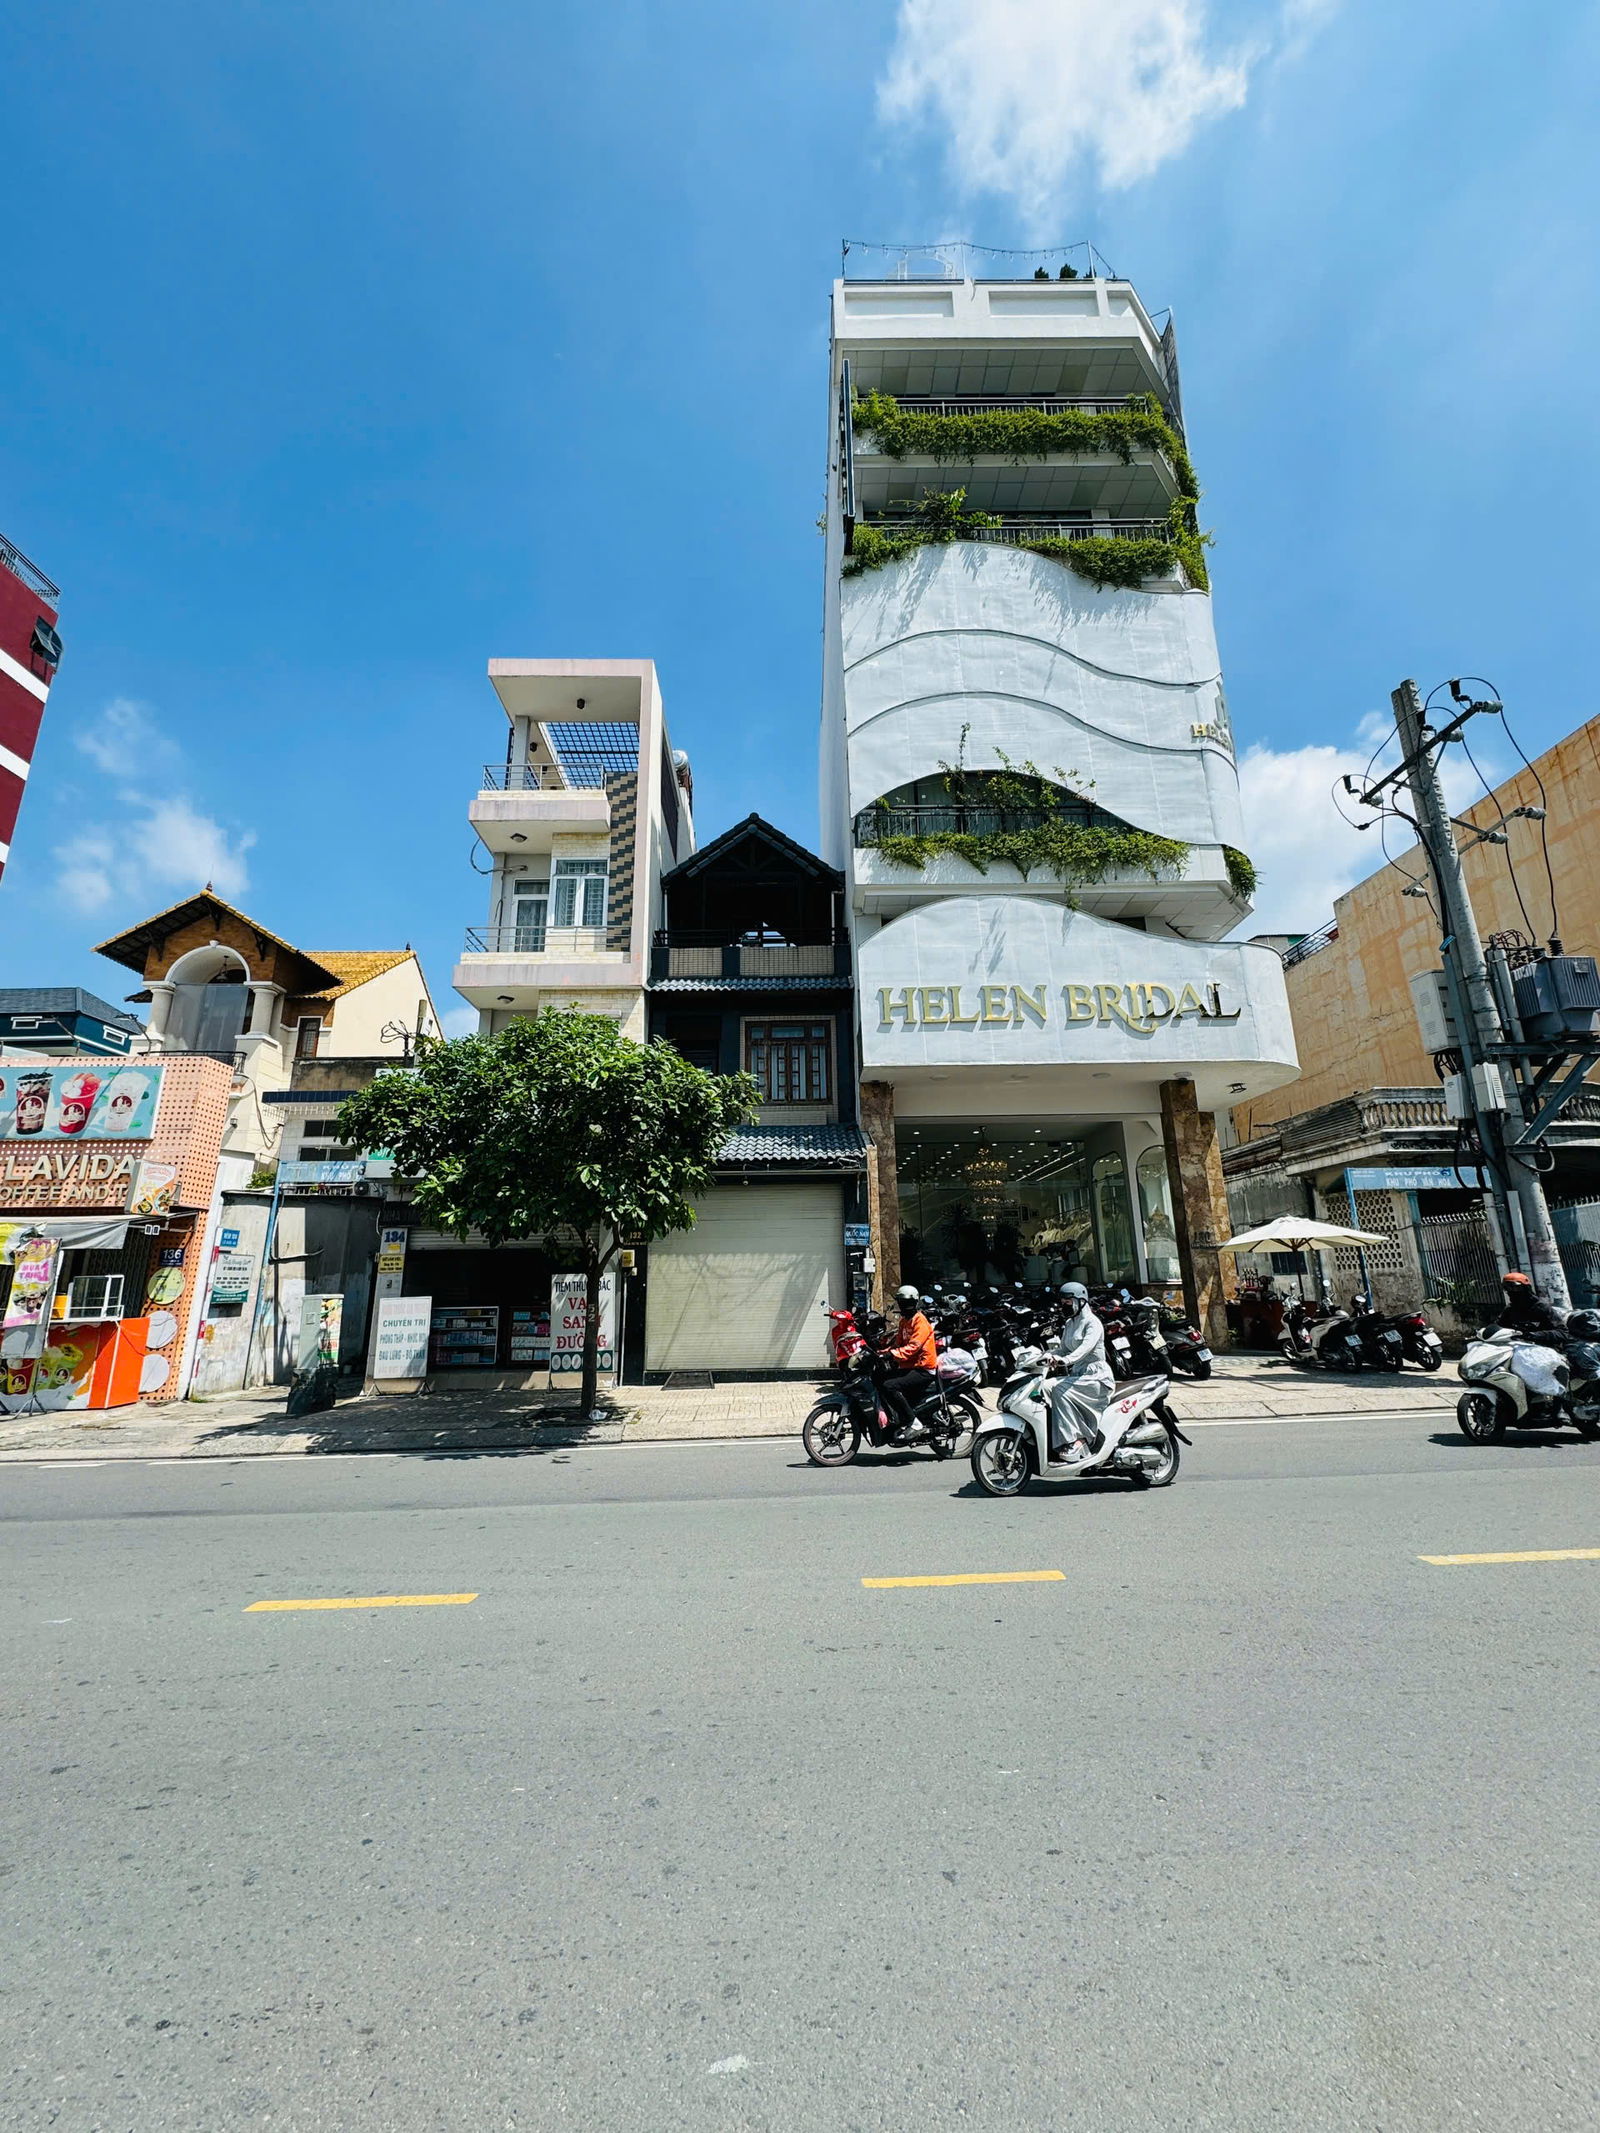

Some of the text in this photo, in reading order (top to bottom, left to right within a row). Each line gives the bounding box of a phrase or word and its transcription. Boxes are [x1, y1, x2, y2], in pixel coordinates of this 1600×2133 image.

[878, 982, 1242, 1033] HELEN BRIDAL
[4, 1154, 136, 1182] LAVIDA
[66, 1186, 110, 1200] AND
[384, 1230, 406, 1243] 134
[163, 1249, 182, 1260] 136
[556, 1332, 607, 1349] ĐƯỜG
